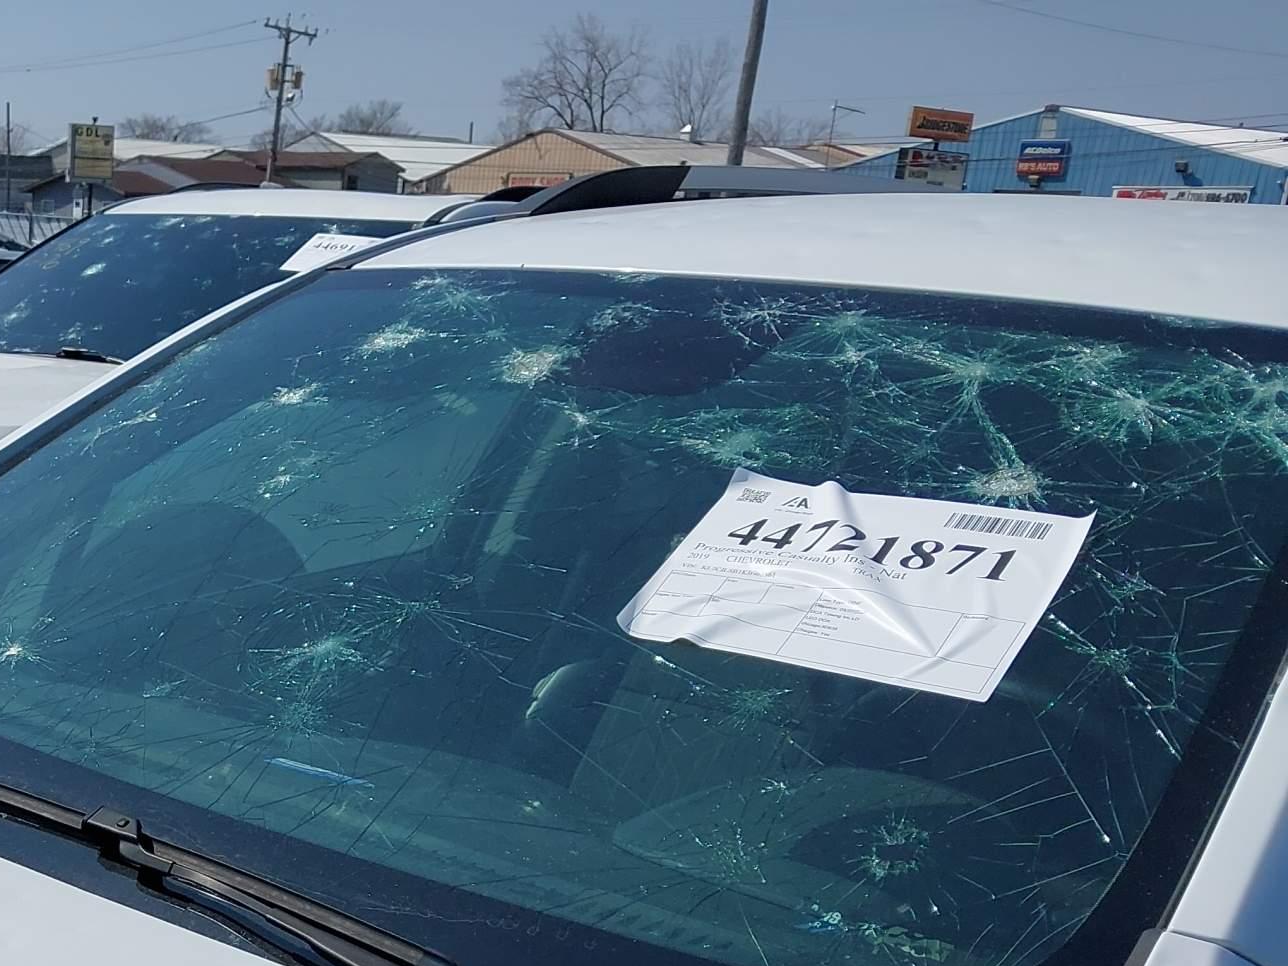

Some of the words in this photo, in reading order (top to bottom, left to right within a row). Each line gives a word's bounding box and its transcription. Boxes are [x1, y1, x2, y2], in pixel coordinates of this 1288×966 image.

[1037, 162, 1059, 171] AUTO
[687, 552, 710, 560] 2019
[726, 555, 793, 567] CHEVROLET
[694, 542, 774, 556] Progressive
[777, 551, 838, 566] Casualty
[843, 553, 865, 565] Ins
[879, 568, 908, 580] Nat
[728, 519, 1016, 582] 44721871
